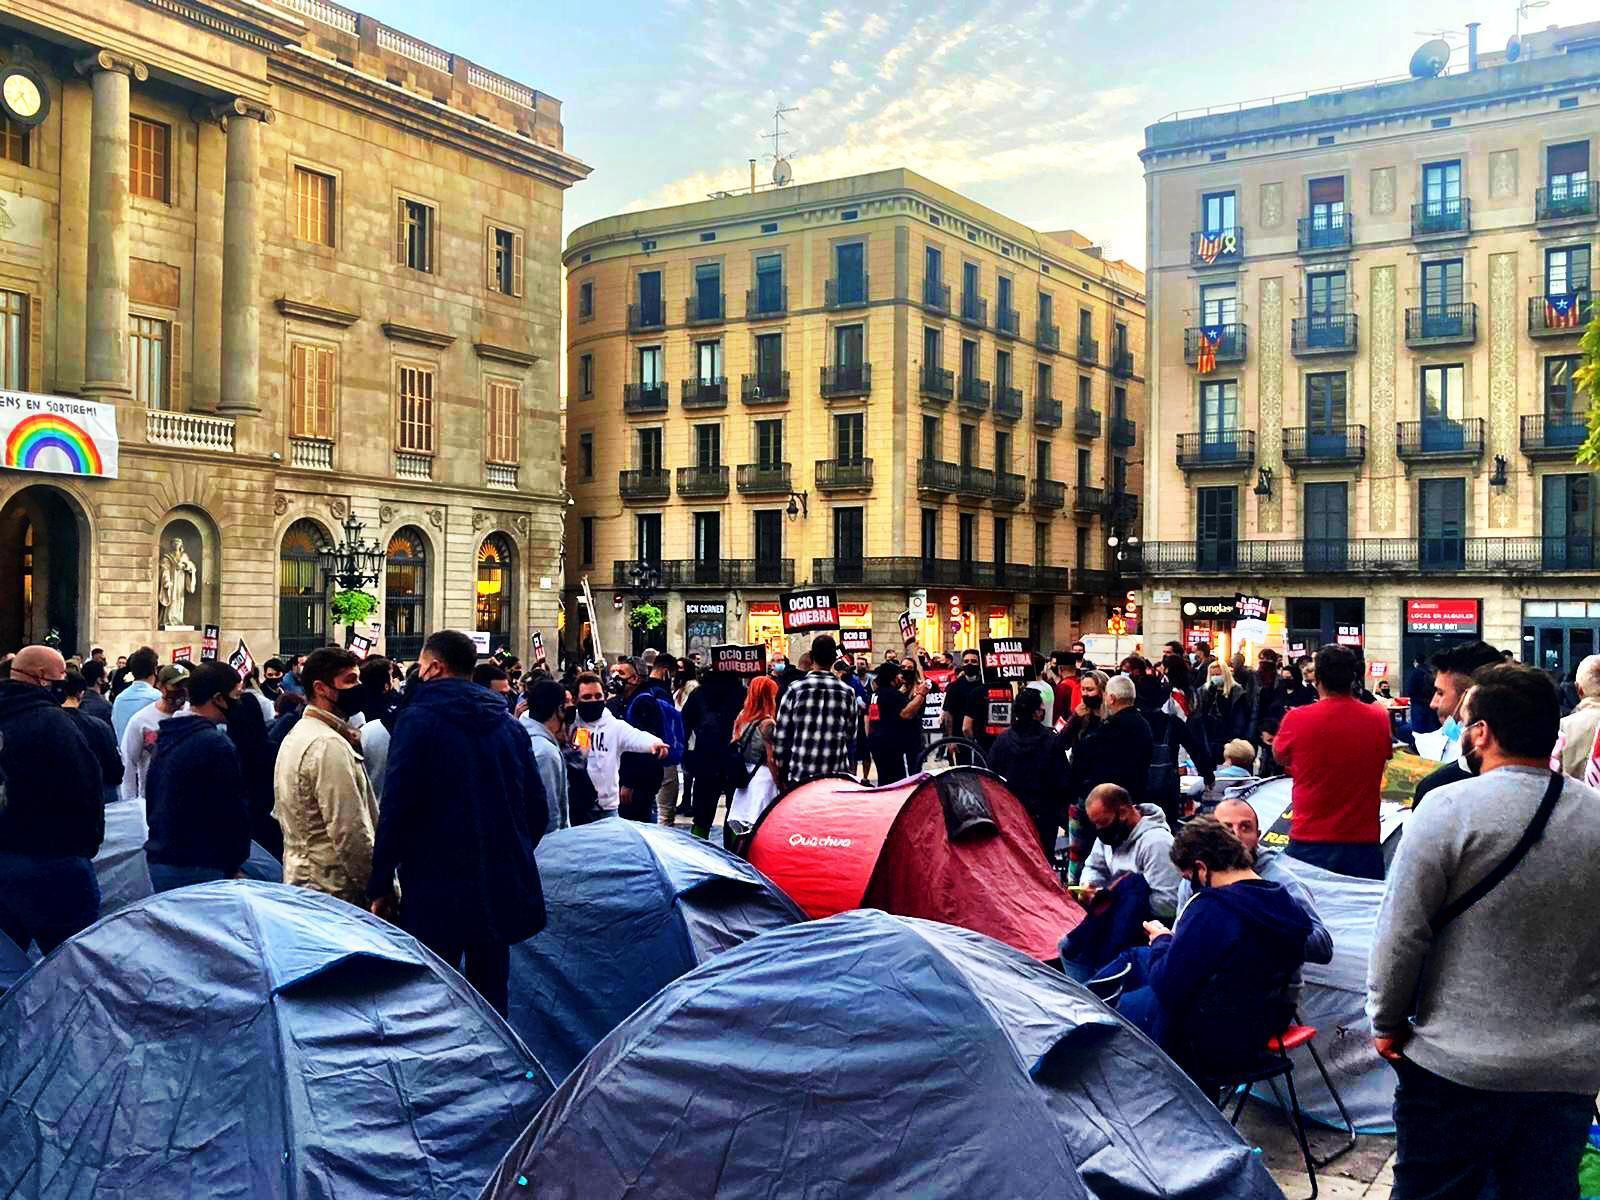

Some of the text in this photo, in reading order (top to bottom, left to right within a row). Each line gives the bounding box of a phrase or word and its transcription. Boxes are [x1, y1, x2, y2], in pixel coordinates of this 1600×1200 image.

[26, 399, 40, 410] EN
[789, 595, 830, 611] OCIO EN
[686, 604, 724, 614] BCN CORNER
[789, 608, 833, 628] QUIEBRA
[843, 631, 868, 640] OCIO EN
[719, 650, 758, 661] OCIO EN
[985, 652, 998, 667] ÉS
[718, 660, 761, 672] QUIEBRA
[997, 667, 1001, 678] I
